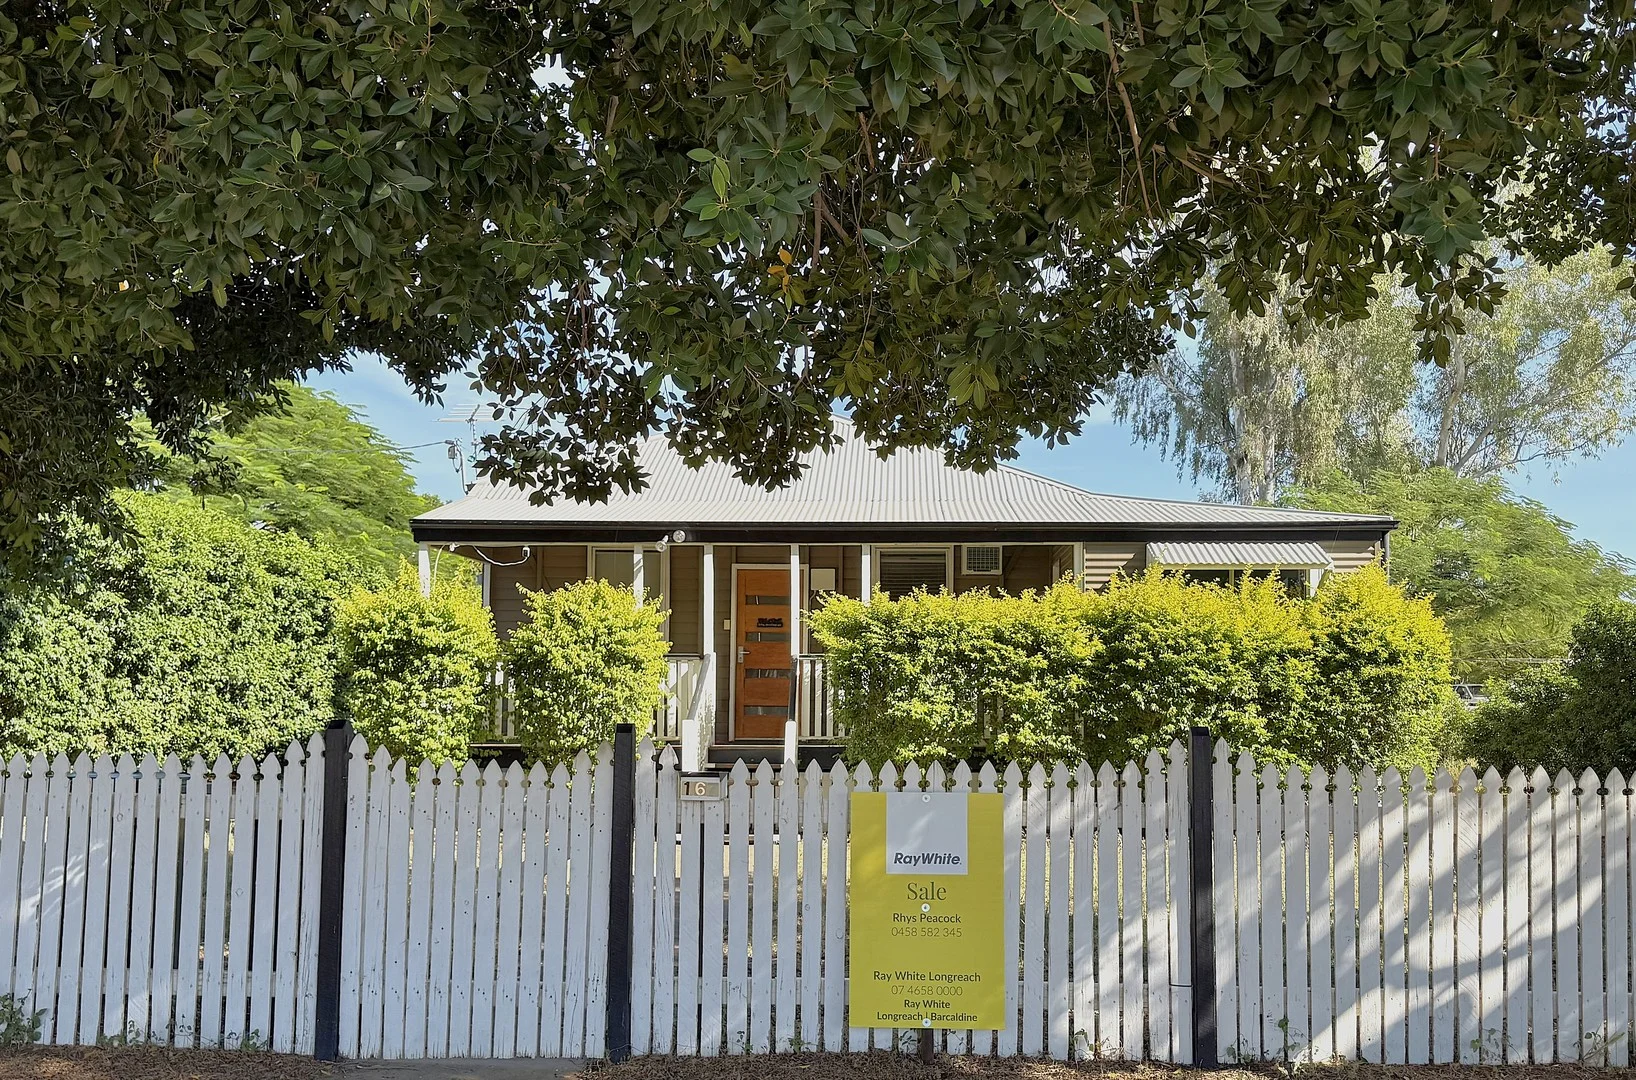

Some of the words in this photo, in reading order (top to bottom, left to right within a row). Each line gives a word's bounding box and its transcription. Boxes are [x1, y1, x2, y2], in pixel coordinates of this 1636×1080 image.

[683, 781, 706, 796] 16
[907, 881, 947, 901] Sale
[892, 912, 917, 924] Rhys
[920, 913, 962, 924] Peacock
[891, 926, 918, 937] 0458
[920, 927, 940, 937] 582
[942, 927, 962, 938] 345
[873, 970, 892, 982] Ray
[895, 971, 926, 981] White
[929, 971, 981, 984] Longreach
[891, 985, 905, 995] 07
[907, 985, 934, 996] 4658
[936, 986, 963, 996] 0000
[904, 999, 921, 1010] Ray
[922, 1000, 951, 1009] White
[877, 1011, 923, 1022] Longreach
[930, 1012, 978, 1022] Barcaldine
